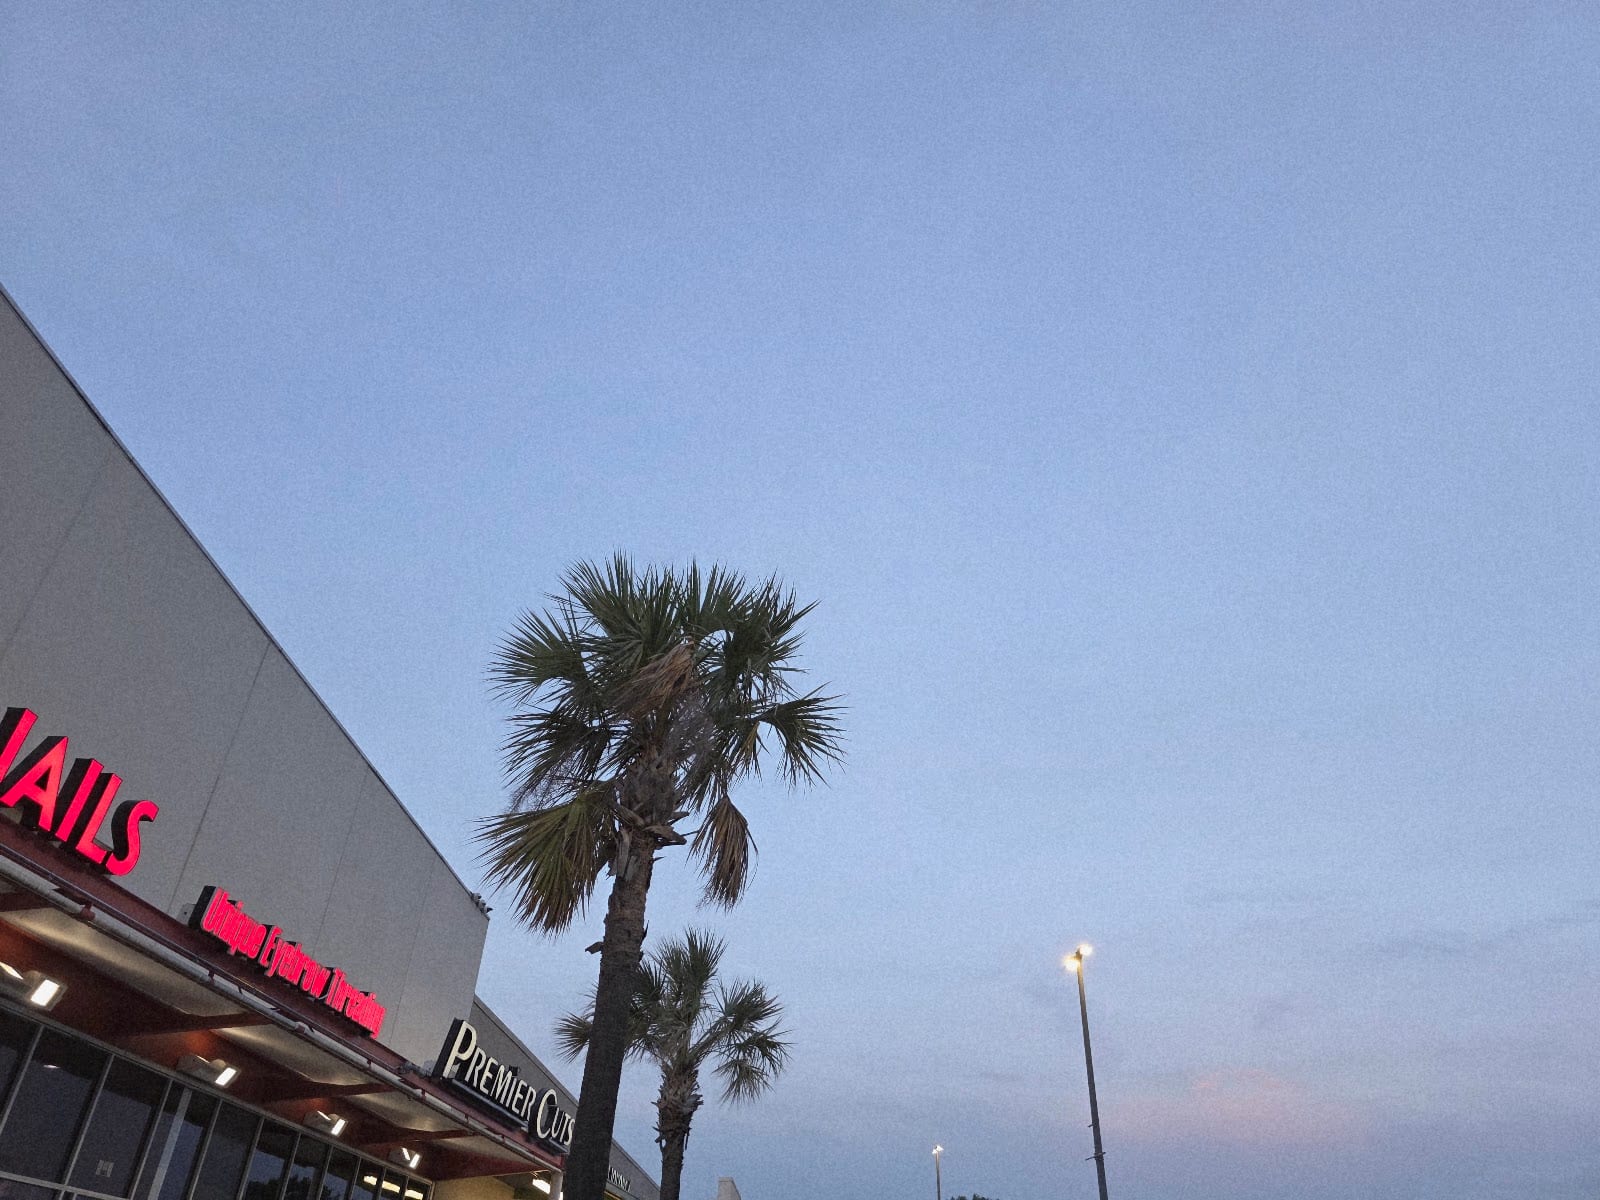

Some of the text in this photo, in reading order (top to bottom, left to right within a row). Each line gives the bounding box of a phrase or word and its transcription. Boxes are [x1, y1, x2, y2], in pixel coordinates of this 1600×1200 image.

[0, 707, 159, 876] AILS
[203, 887, 267, 959] Unique
[442, 1020, 576, 1146] PREMIER CUTS
